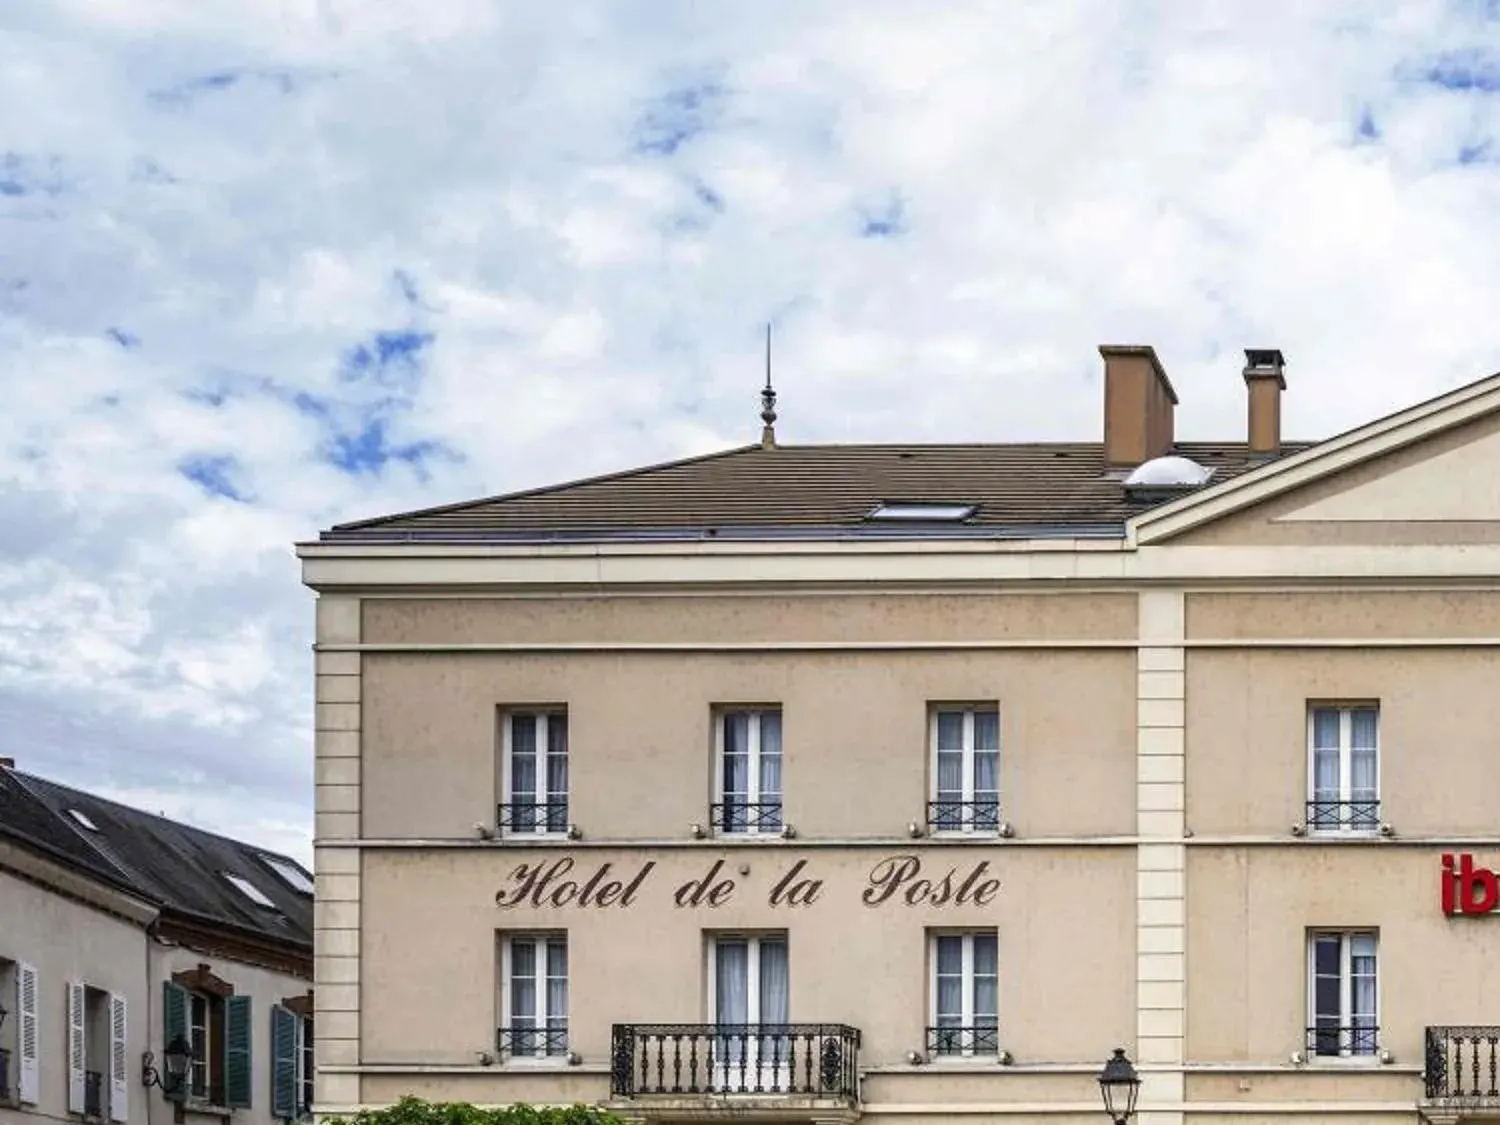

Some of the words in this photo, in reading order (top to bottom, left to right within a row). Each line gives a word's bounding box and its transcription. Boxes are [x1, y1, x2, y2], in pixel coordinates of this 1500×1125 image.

[495, 856, 656, 908] Hotel
[674, 859, 736, 908] de
[768, 859, 824, 908] la
[862, 855, 1001, 908] Poste
